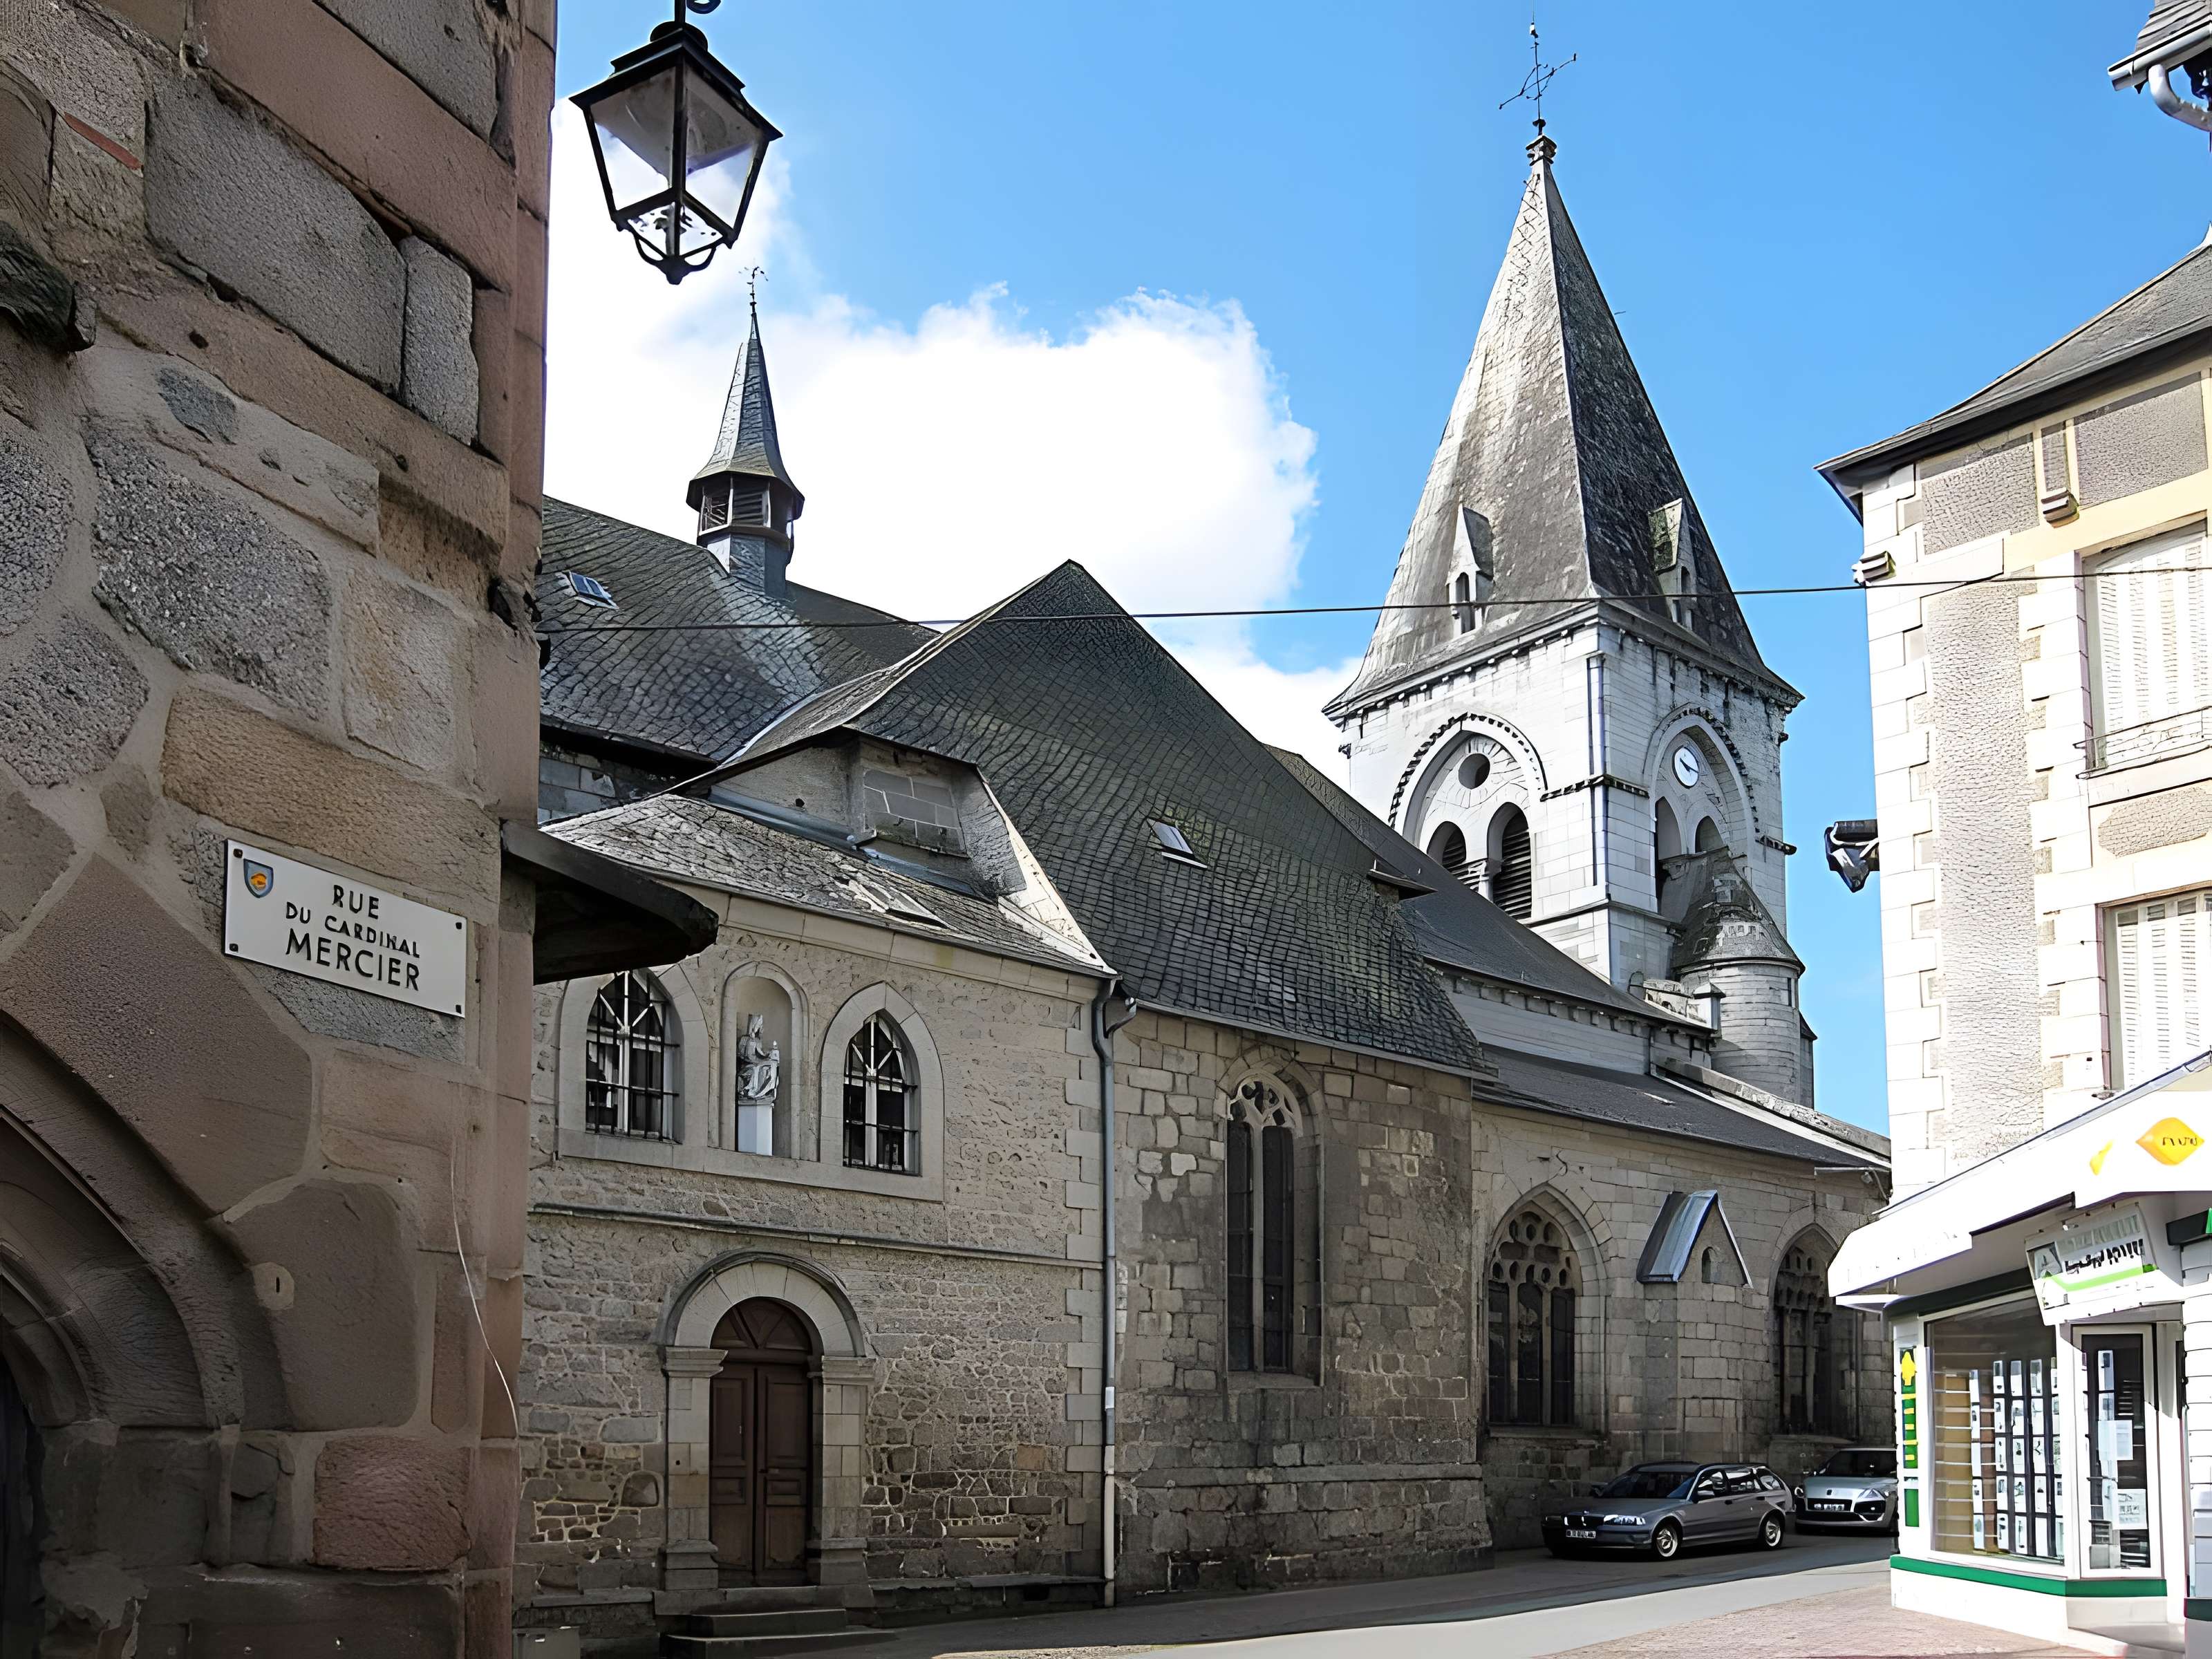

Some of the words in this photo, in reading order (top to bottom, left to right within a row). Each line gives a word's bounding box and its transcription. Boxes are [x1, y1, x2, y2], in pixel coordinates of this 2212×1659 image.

[285, 901, 311, 924] DU
[324, 915, 420, 959] CARDINAL
[332, 884, 379, 919] RUE
[285, 928, 420, 991] MERCIER
